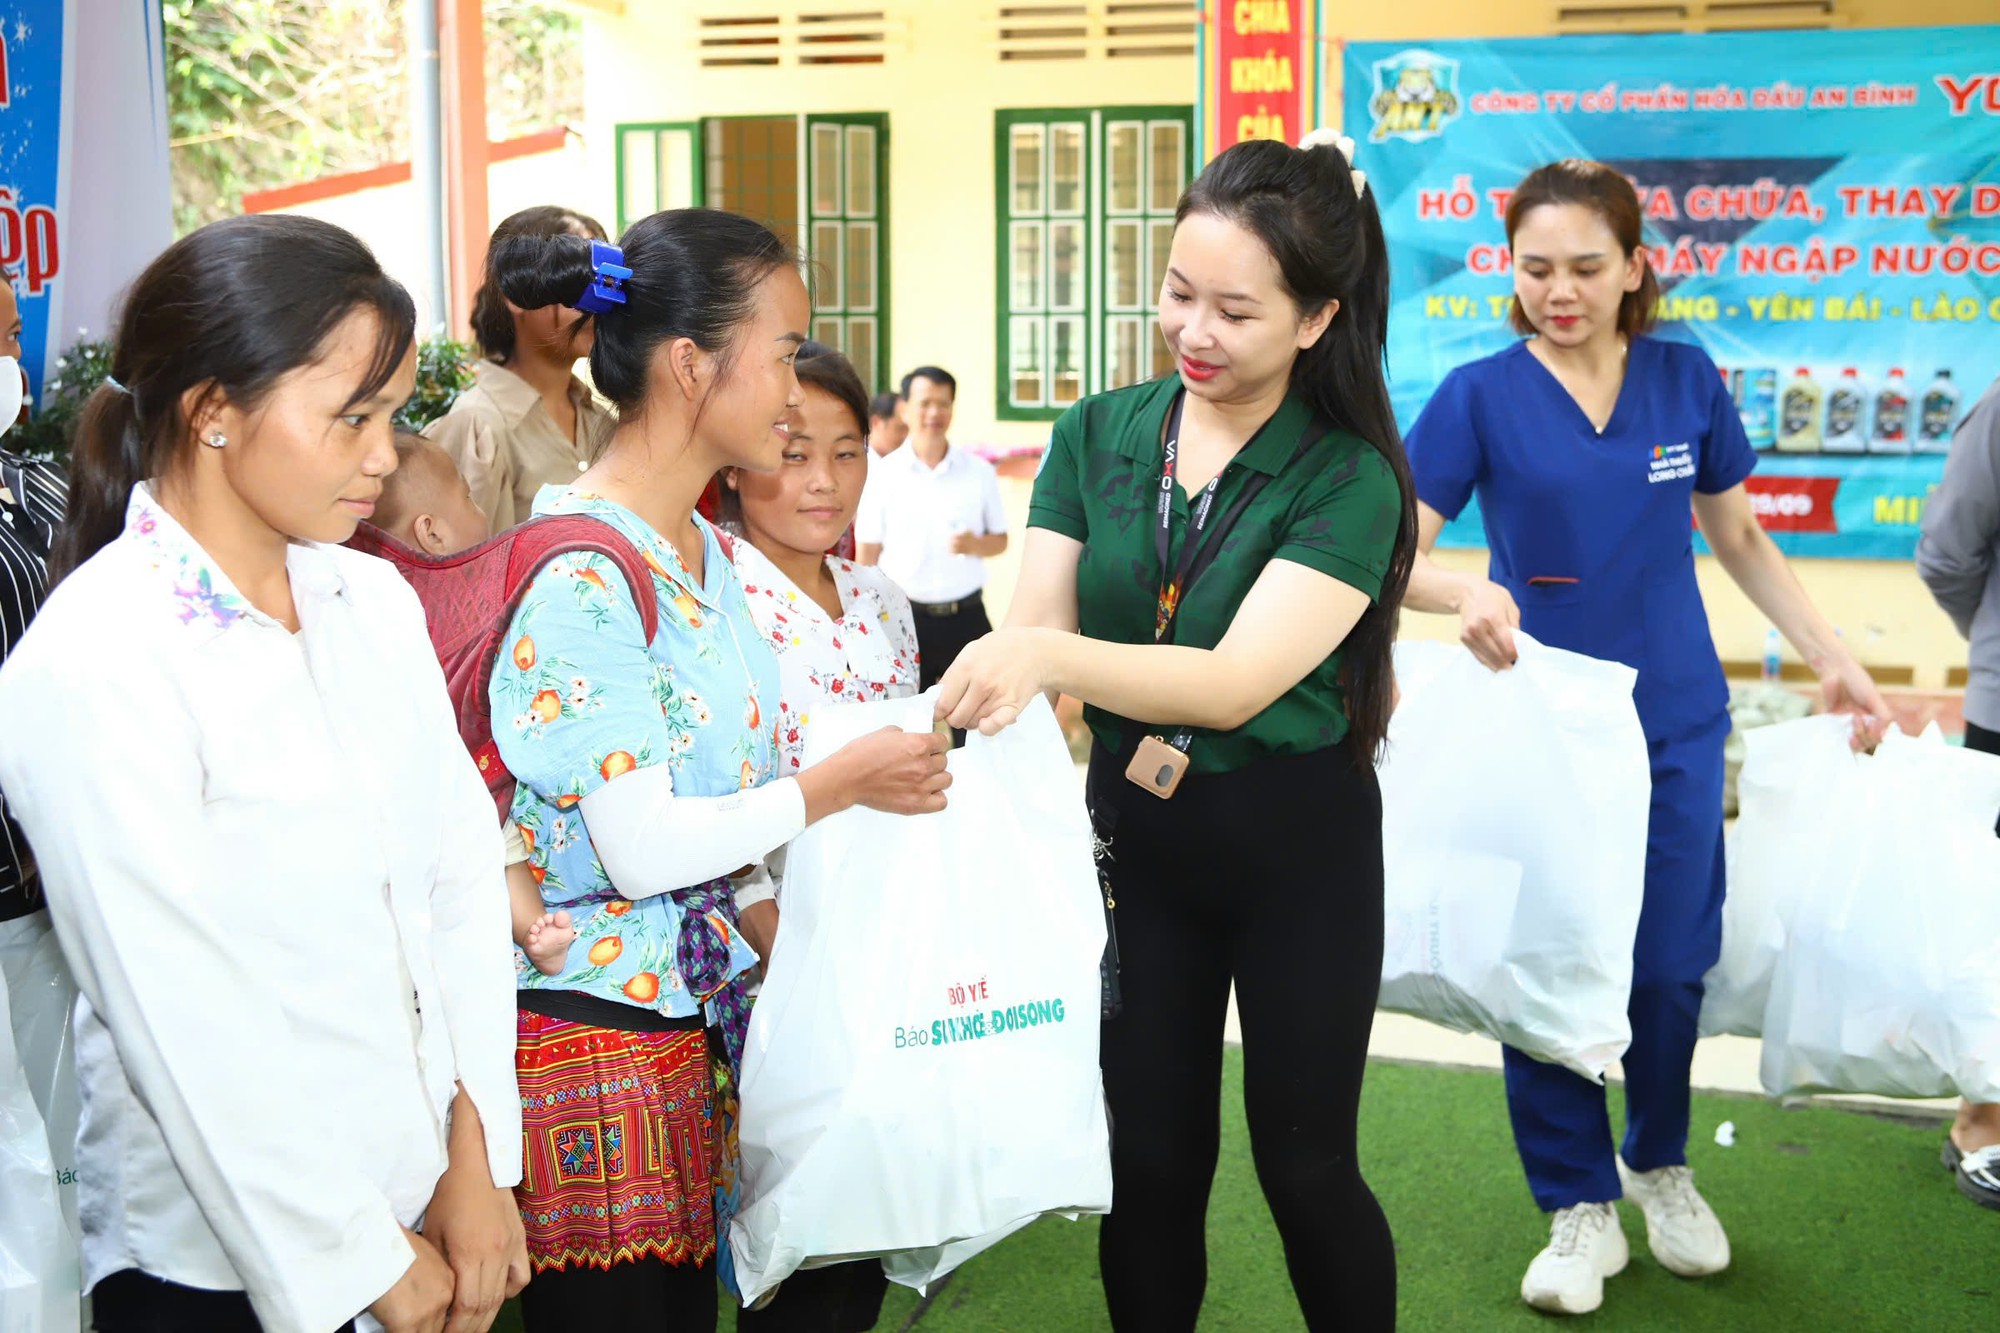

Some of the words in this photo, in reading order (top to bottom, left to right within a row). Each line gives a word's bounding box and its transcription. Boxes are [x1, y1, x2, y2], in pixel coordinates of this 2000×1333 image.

[1231, 47, 1294, 94] KHÓA
[1471, 88, 1539, 112] CÔNG
[1544, 91, 1577, 112] TY
[1810, 84, 1848, 108] AN
[1418, 175, 1477, 219] HỖ
[1684, 177, 1826, 223] CHỮA,
[1838, 186, 1959, 218] THAY
[1739, 236, 1859, 284] NGẬP
[1871, 234, 2000, 275] NƯỚC
[1426, 295, 1478, 319] KV:
[1747, 290, 1814, 321] YÊN
[1823, 290, 1883, 321] BÁI
[1910, 289, 1979, 321] LÀO
[895, 1025, 928, 1048] Báo
